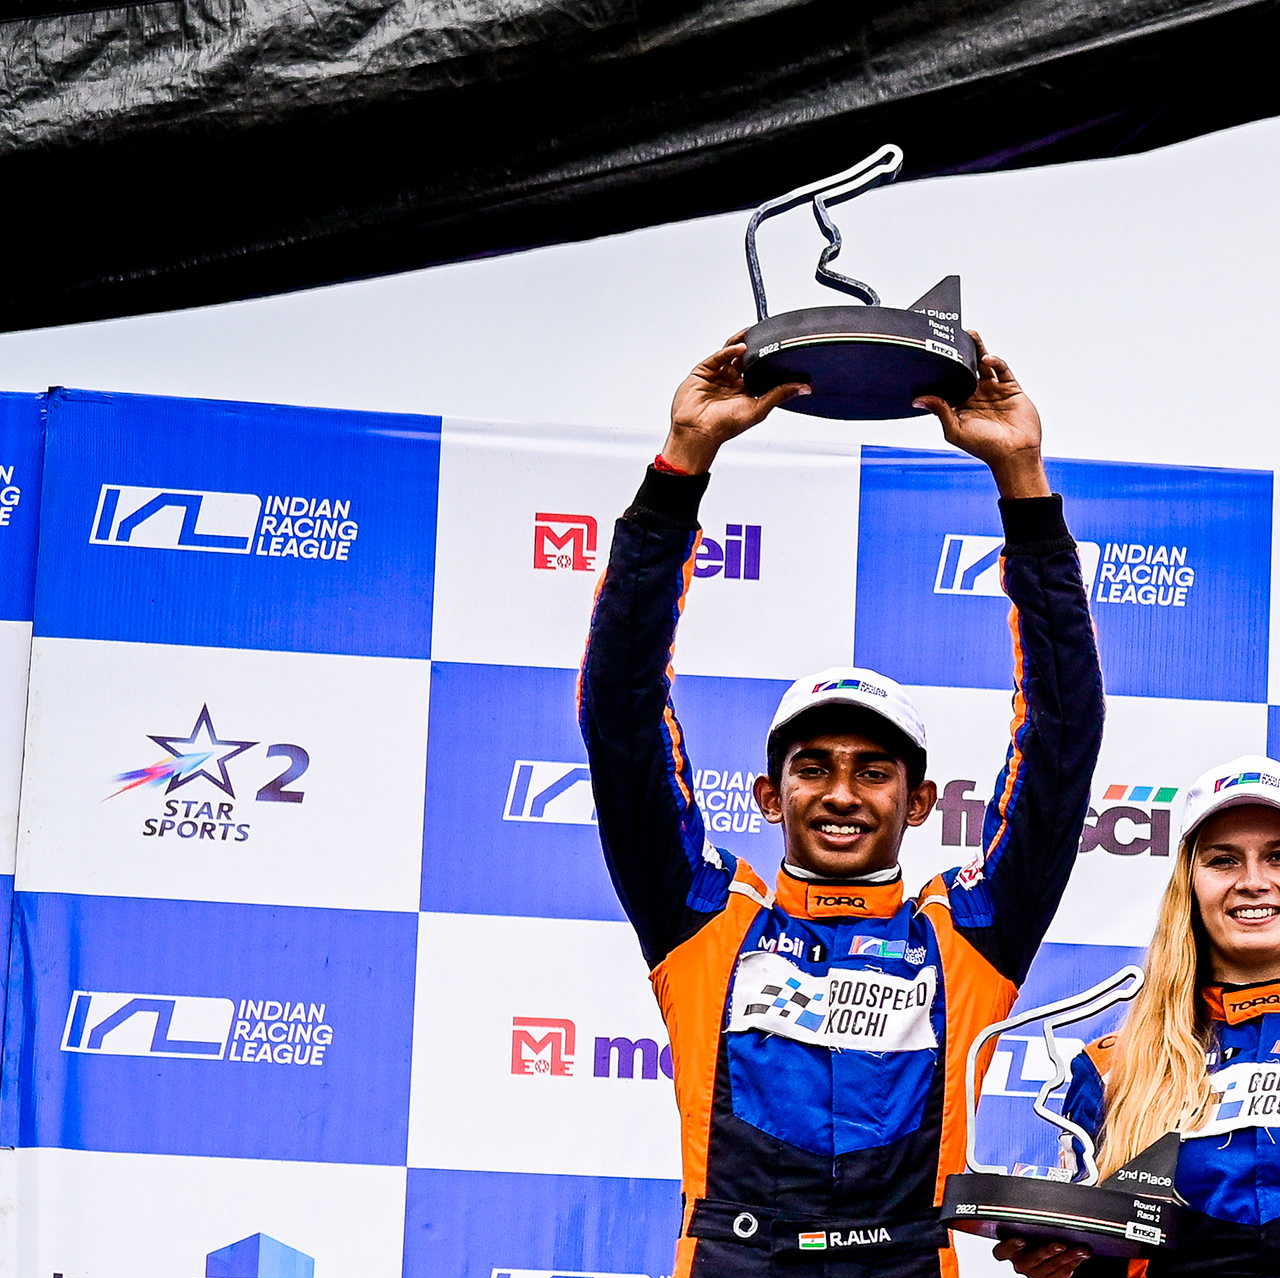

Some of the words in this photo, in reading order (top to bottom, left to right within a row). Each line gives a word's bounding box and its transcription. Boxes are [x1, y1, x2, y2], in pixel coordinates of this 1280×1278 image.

[264, 494, 351, 520] INDIAN
[261, 516, 358, 541] RACING
[256, 535, 350, 562] LEAGUE
[693, 523, 762, 581] eil
[1103, 543, 1186, 566] INDIAN
[1100, 563, 1194, 587] RACING
[1096, 583, 1187, 607] LEAGUE
[255, 745, 310, 804] 2
[163, 799, 234, 821] STAR
[703, 811, 761, 833] AGUE
[142, 818, 250, 843] SPORTS
[814, 896, 867, 910] TORQ
[828, 979, 928, 1011] GODSPEED
[238, 999, 326, 1023] INDIAN
[824, 1009, 888, 1037] KOCHI
[233, 1020, 333, 1046] RACING
[229, 1040, 324, 1066] LEAGUE
[1117, 1169, 1138, 1181] 2nd
[1139, 1173, 1172, 1187] Place
[1133, 1200, 1155, 1212] Round
[1155, 1205, 1162, 1213] 4
[1136, 1209, 1155, 1221] Race
[1155, 1213, 1161, 1222] 2
[830, 1227, 892, 1248] R.ALVA
